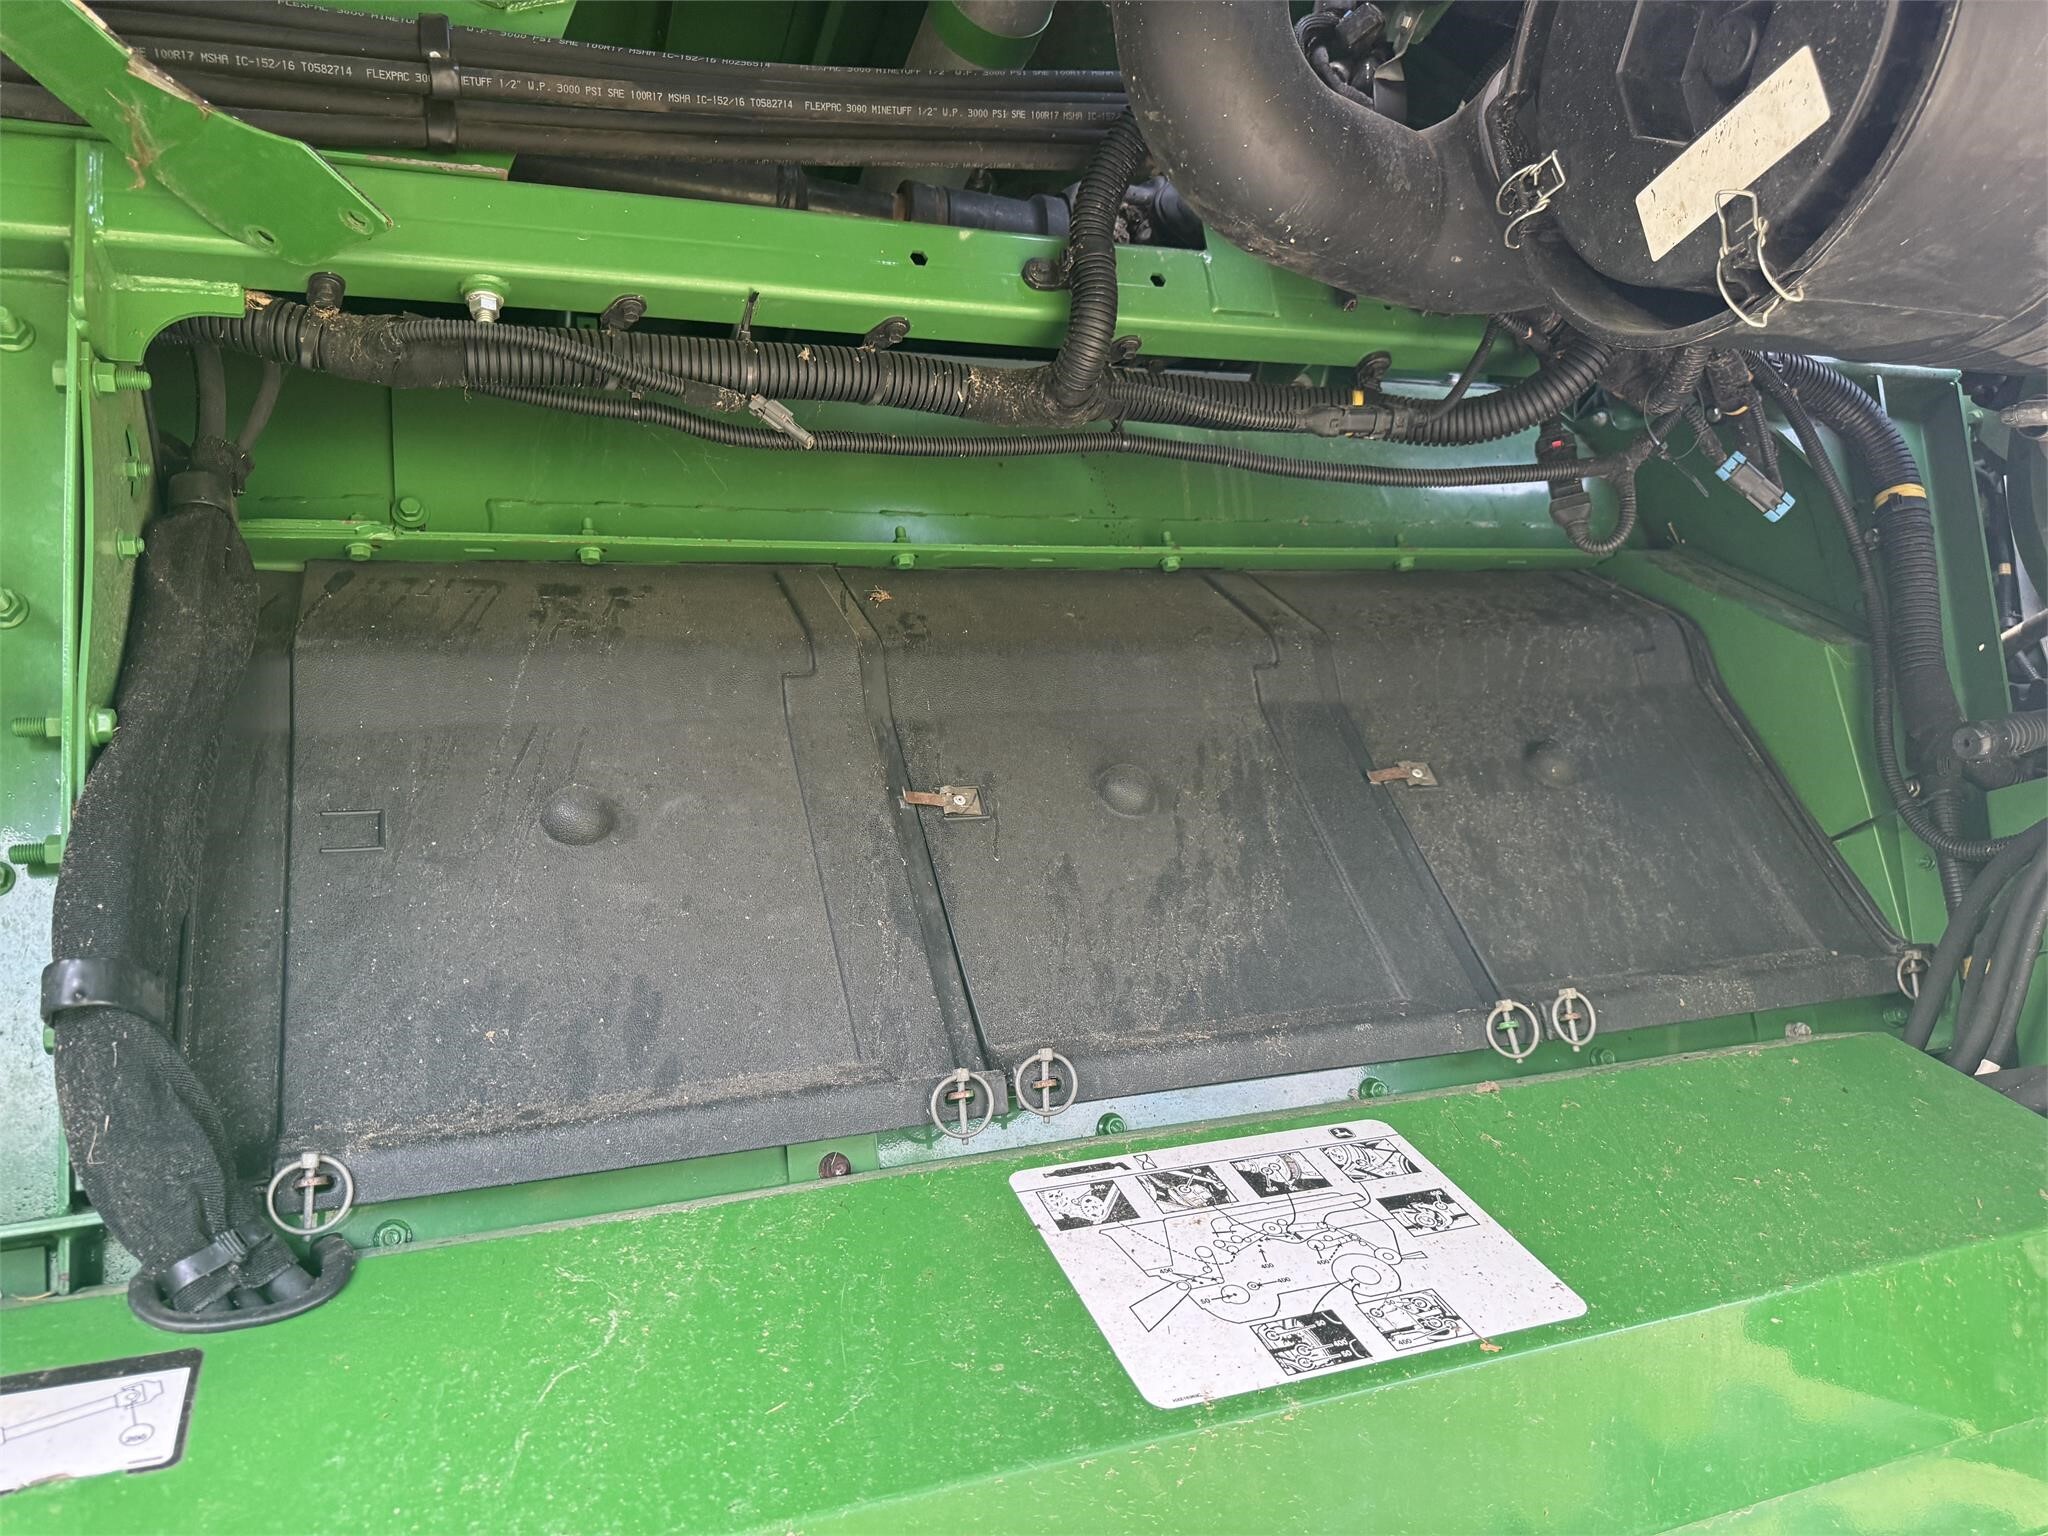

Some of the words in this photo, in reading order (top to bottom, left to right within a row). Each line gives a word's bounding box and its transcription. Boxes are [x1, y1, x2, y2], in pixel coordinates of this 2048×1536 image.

[154, 48, 194, 62] 100R17
[201, 51, 229, 65] MSHA
[236, 55, 295, 71] IC-152/16
[300, 62, 353, 77] T0582714
[366, 68, 410, 82] FLEXPAC
[500, 79, 521, 89] 1/2"
[556, 83, 581, 95] 3000
[585, 86, 602, 97] PSI
[607, 88, 625, 99] SAE
[631, 90, 663, 101] 100R17
[668, 92, 691, 104] MSHA
[696, 94, 745, 107] IC-152/16
[750, 97, 793, 109] T0582714
[804, 101, 842, 113] FLEXPAC
[846, 103, 867, 114] 3000
[871, 105, 912, 116] MINETUFF
[918, 107, 938, 117] 1/2"
[967, 108, 988, 118] 3000
[992, 109, 1007, 119] PSI
[1011, 110, 1026, 119] SAE
[1031, 111, 1059, 120] 100R17
[1398, 1338, 1412, 1346] 400
